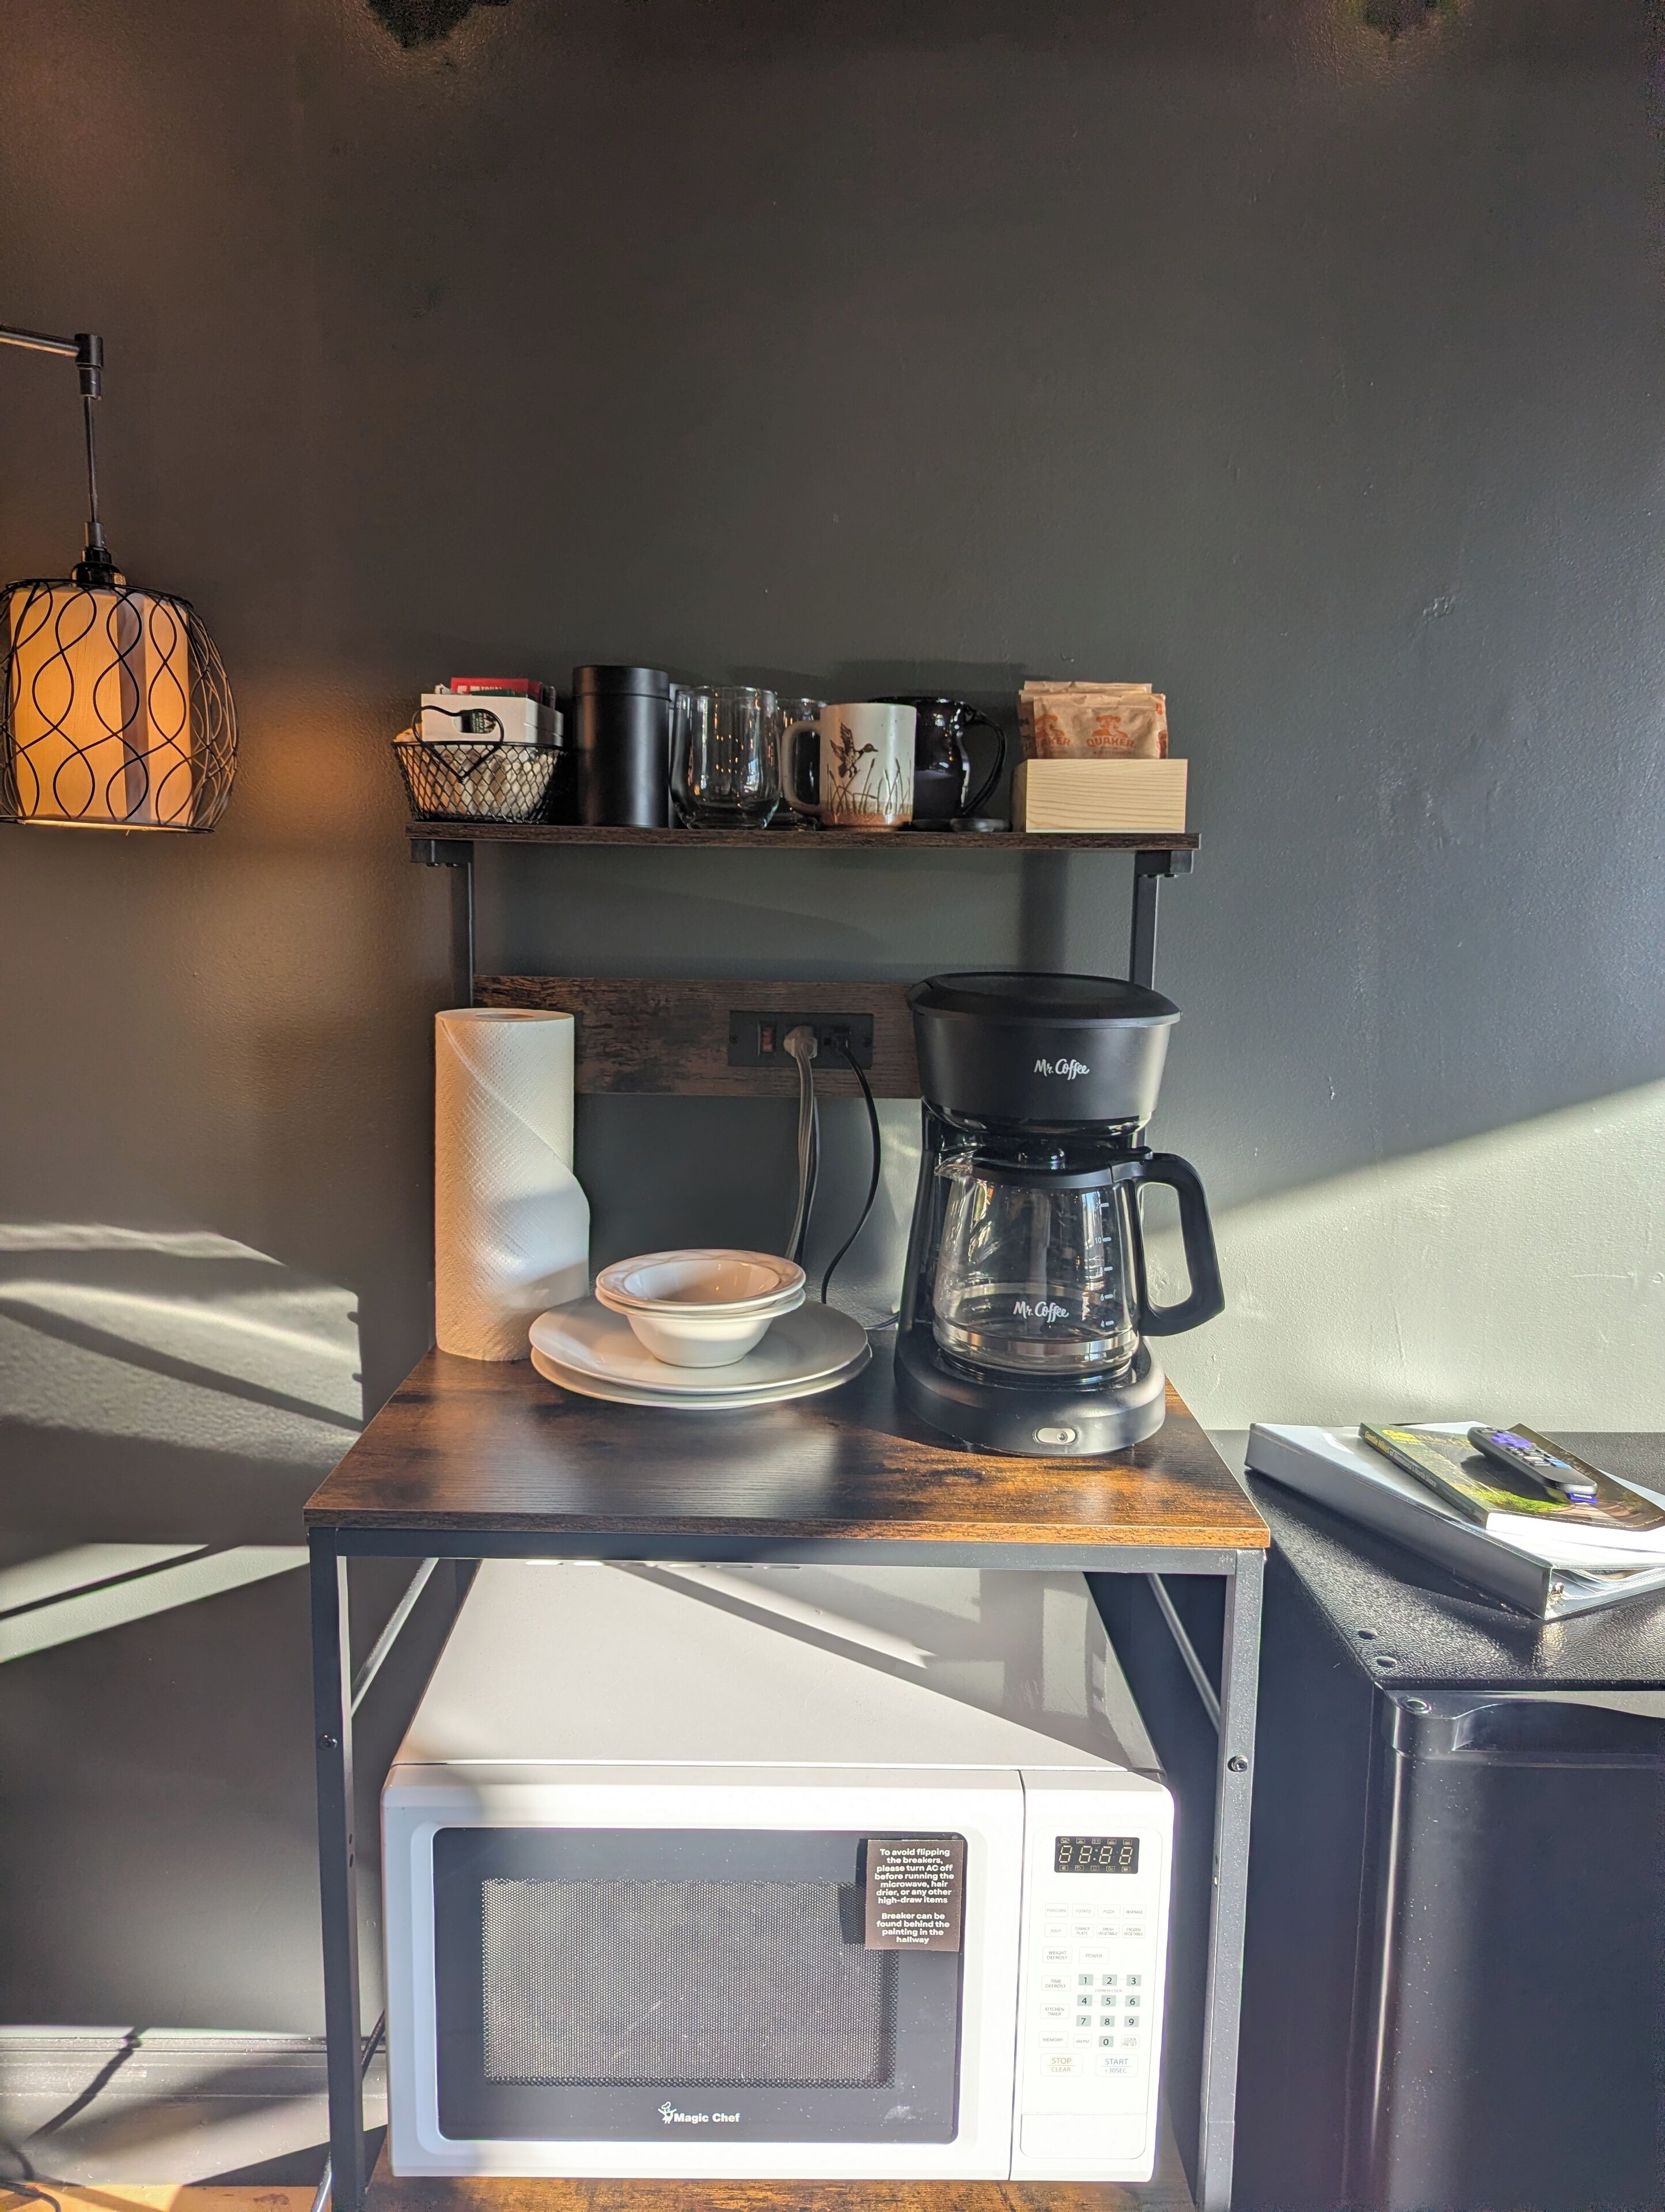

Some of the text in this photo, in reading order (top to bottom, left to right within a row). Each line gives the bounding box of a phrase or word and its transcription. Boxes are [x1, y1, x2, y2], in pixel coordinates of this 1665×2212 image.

[1086, 737, 1134, 747] QUAKER
[1034, 1059, 1090, 1080] Mr. Coffee
[1013, 1301, 1069, 1323] Mr. Coffee
[917, 1849, 950, 1857] flipping
[877, 1865, 905, 1873] please
[905, 1873, 938, 1881] running
[878, 1897, 922, 1905] high-draw
[882, 1929, 918, 1937] painting
[674, 2113, 740, 2124] Magic Chef
